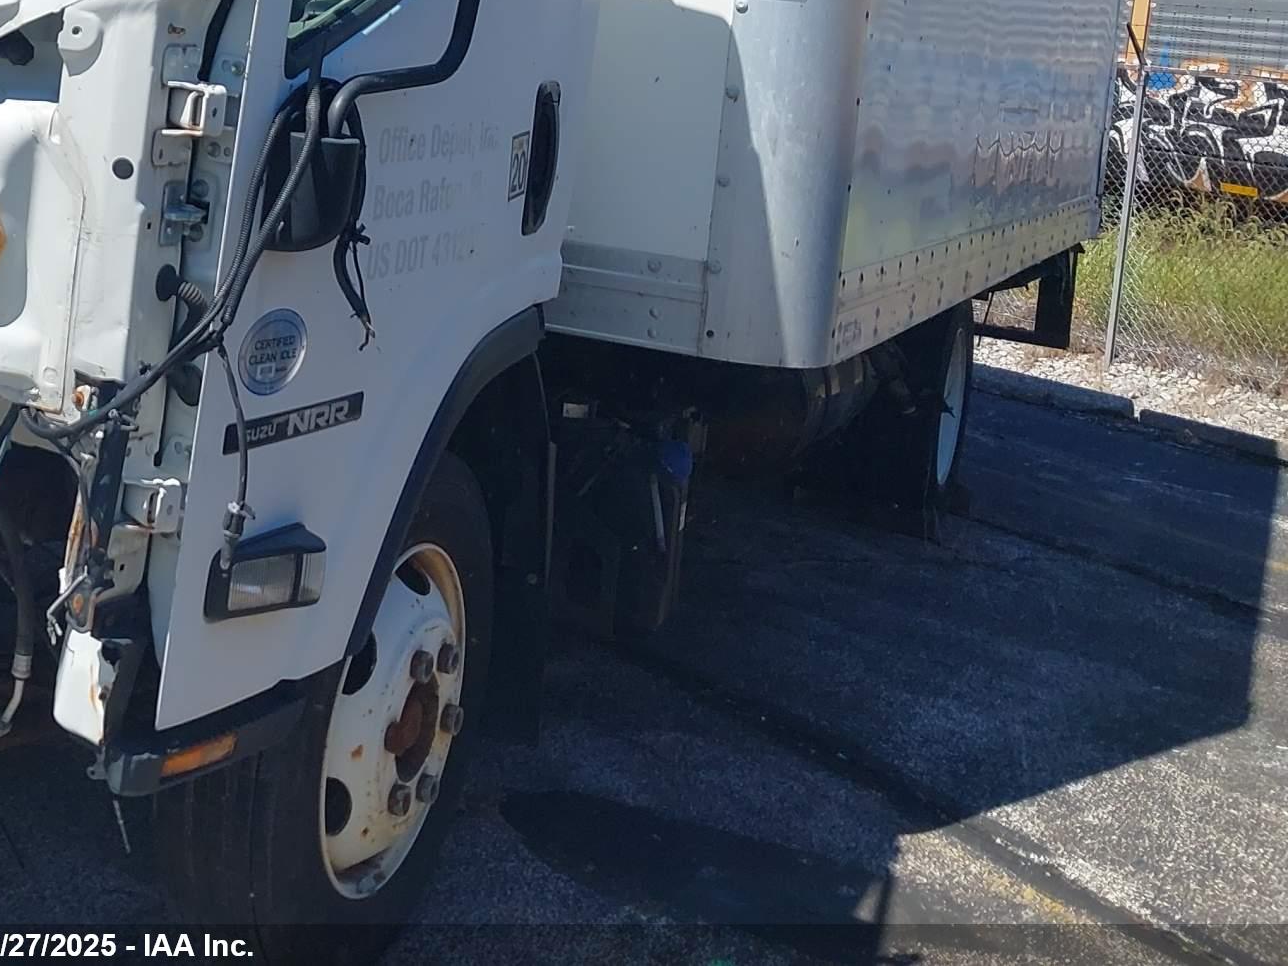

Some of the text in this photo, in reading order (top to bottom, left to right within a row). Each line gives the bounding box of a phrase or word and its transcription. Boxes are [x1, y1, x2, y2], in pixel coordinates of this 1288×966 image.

[378, 126, 426, 165] Office
[372, 183, 414, 221] Boca
[394, 234, 429, 275] DOT
[248, 348, 277, 366] CLEAN
[287, 400, 350, 436] NRR
